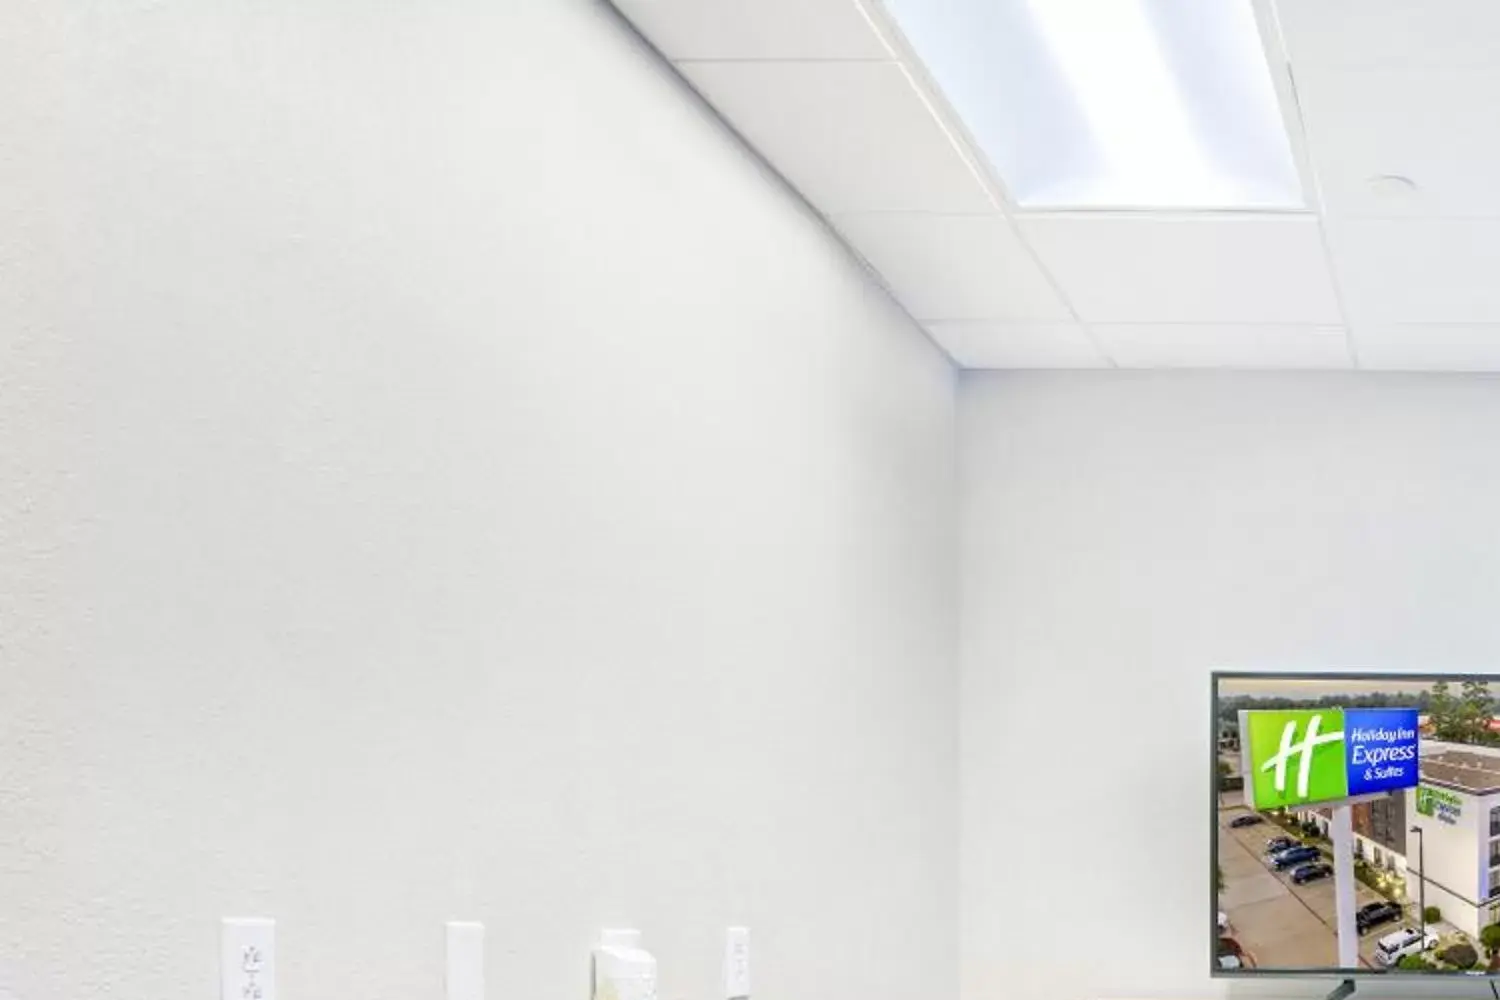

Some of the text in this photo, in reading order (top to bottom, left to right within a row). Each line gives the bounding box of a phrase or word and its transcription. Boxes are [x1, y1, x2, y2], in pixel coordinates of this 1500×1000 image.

[1352, 745, 1416, 766] Express
[1364, 766, 1404, 780] & Suites
